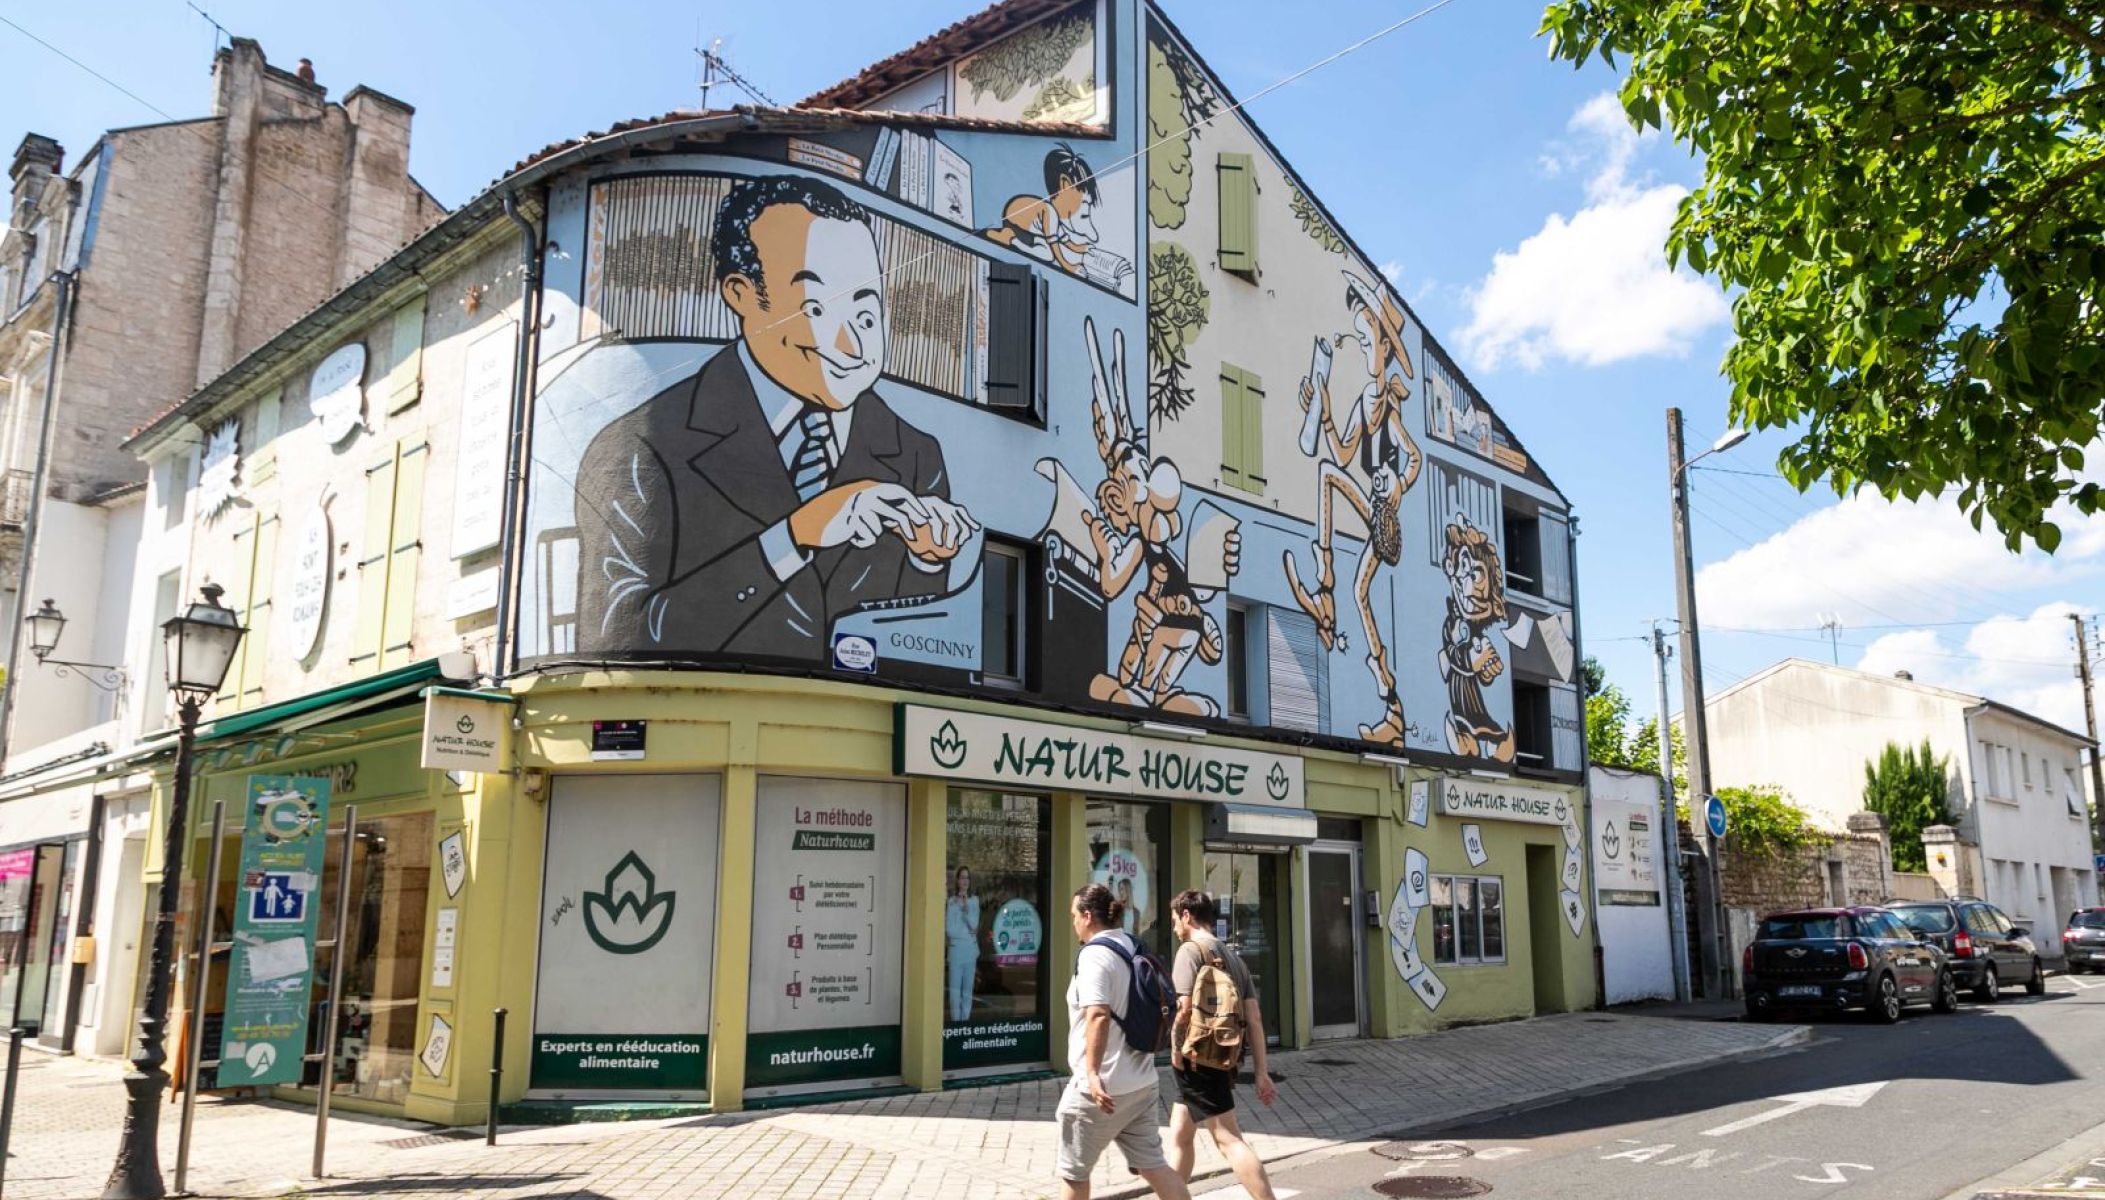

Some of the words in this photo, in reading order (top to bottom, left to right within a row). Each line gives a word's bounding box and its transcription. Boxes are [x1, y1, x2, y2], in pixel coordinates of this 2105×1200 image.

[890, 632, 975, 659] GOSCINNY
[466, 739, 496, 748] HOUSE
[993, 732, 1131, 784] NATUR
[1139, 749, 1249, 796] HOUSE
[1463, 792, 1508, 811] NATUR
[1512, 796, 1551, 816] HOUSE
[795, 806, 811, 824] La
[816, 808, 873, 827] méthode
[800, 833, 871, 850] Naturhouse
[973, 1026, 985, 1035] en
[987, 1020, 1043, 1035] rééducation
[541, 1040, 593, 1055] Experts
[596, 1042, 613, 1053] en
[616, 1039, 700, 1054] rééducation
[962, 1035, 1018, 1050] alimentaire
[578, 1055, 660, 1069] alimentaire
[770, 1042, 876, 1065] naturhouse.fr
